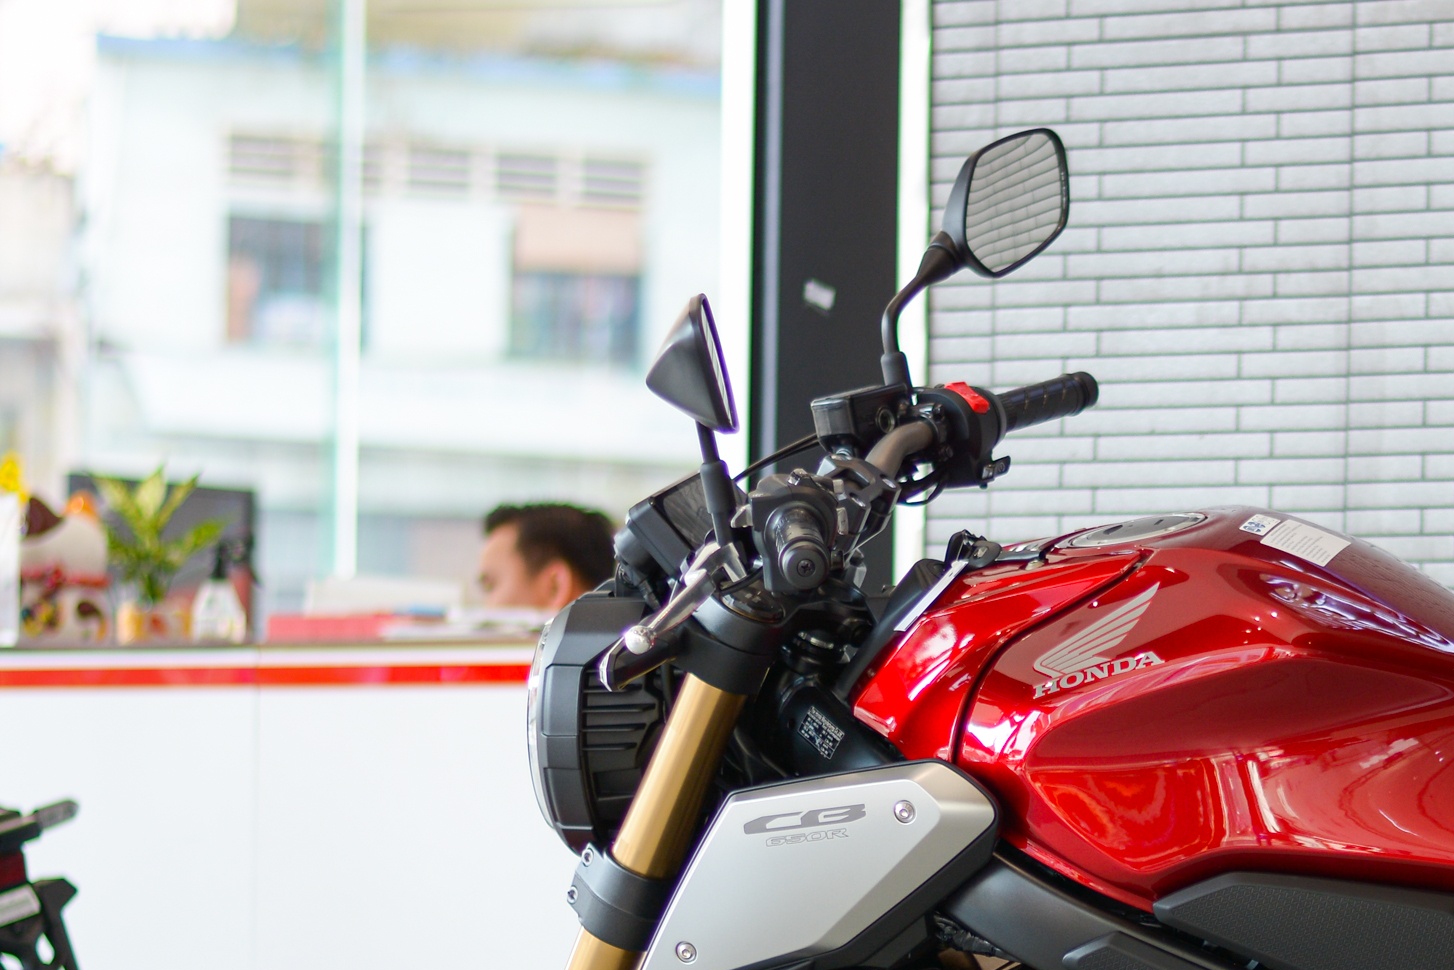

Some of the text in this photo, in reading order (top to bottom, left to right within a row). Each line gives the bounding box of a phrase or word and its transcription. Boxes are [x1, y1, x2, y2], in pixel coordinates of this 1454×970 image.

[1033, 651, 1165, 699] HONDA
[743, 803, 867, 835] CB
[765, 828, 849, 847] 650R
